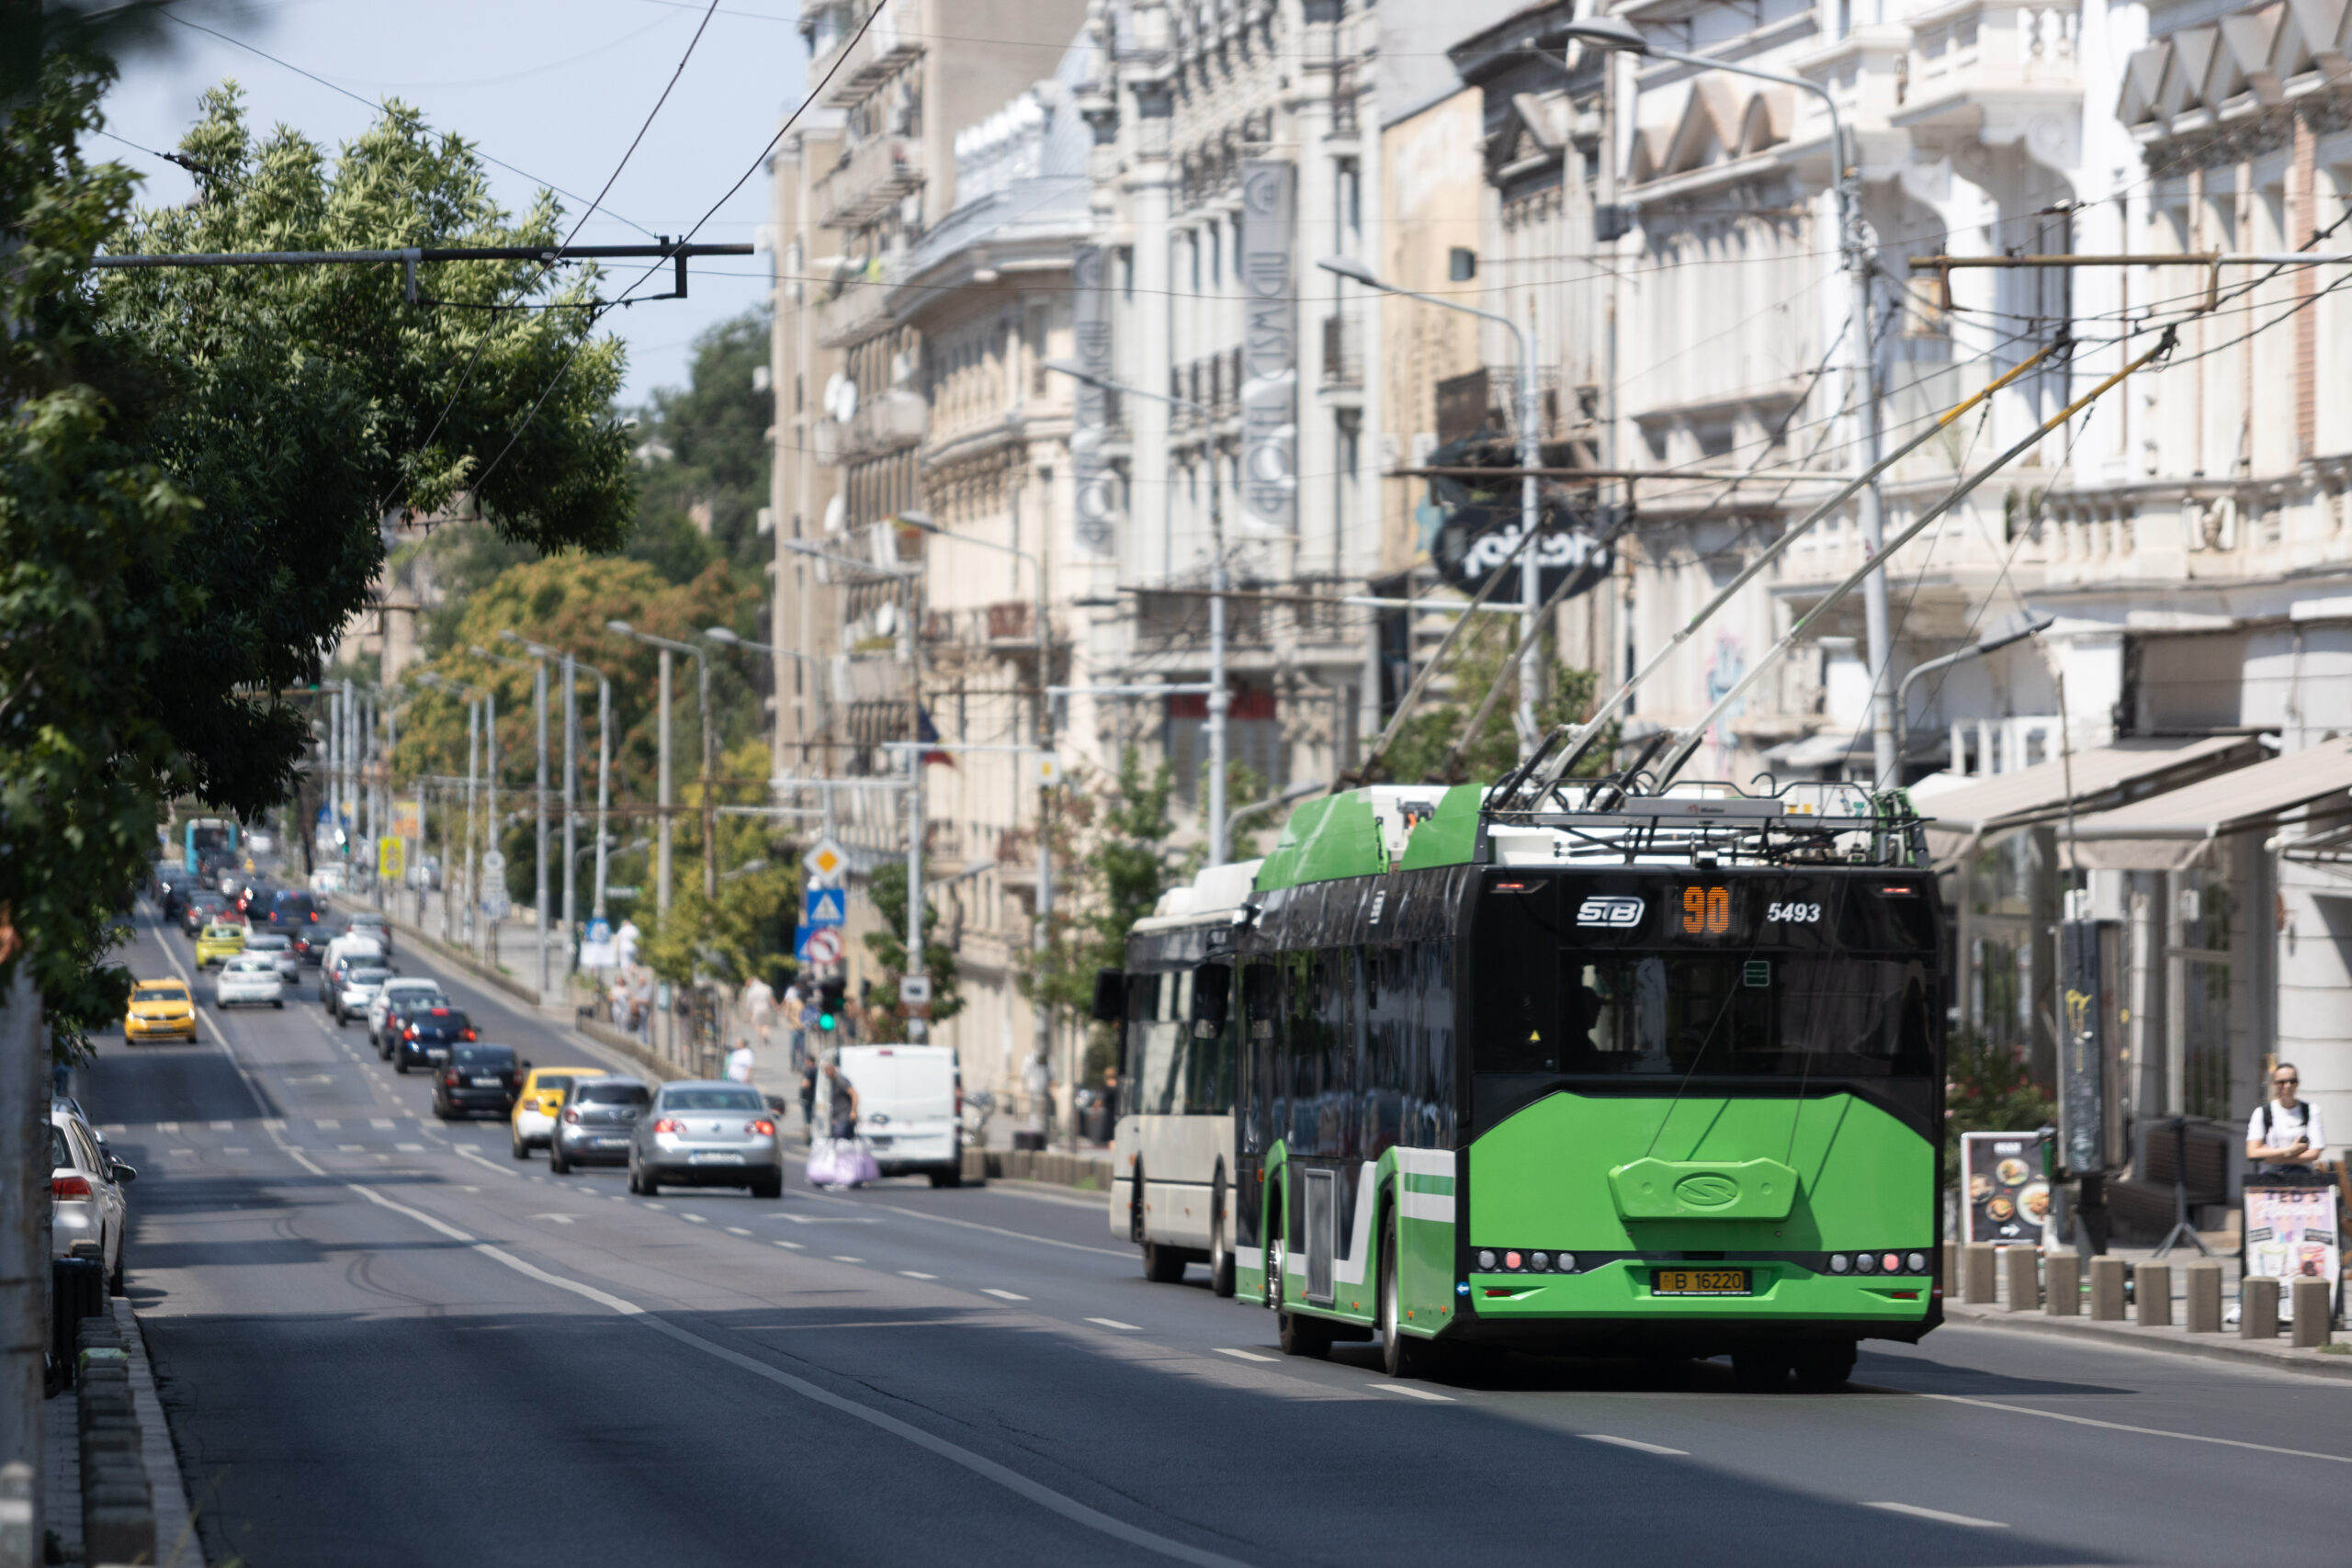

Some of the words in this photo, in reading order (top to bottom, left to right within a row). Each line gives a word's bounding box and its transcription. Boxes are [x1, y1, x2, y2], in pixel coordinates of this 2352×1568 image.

[1249, 252, 1288, 380] CISMIGIU
[1249, 406, 1288, 513] HOTEL
[1577, 900, 1638, 922] STB
[1682, 886, 1730, 933] 90
[1767, 902, 1821, 922] 5493
[1675, 1273, 1687, 1290] B
[1694, 1273, 1741, 1290] 16220
